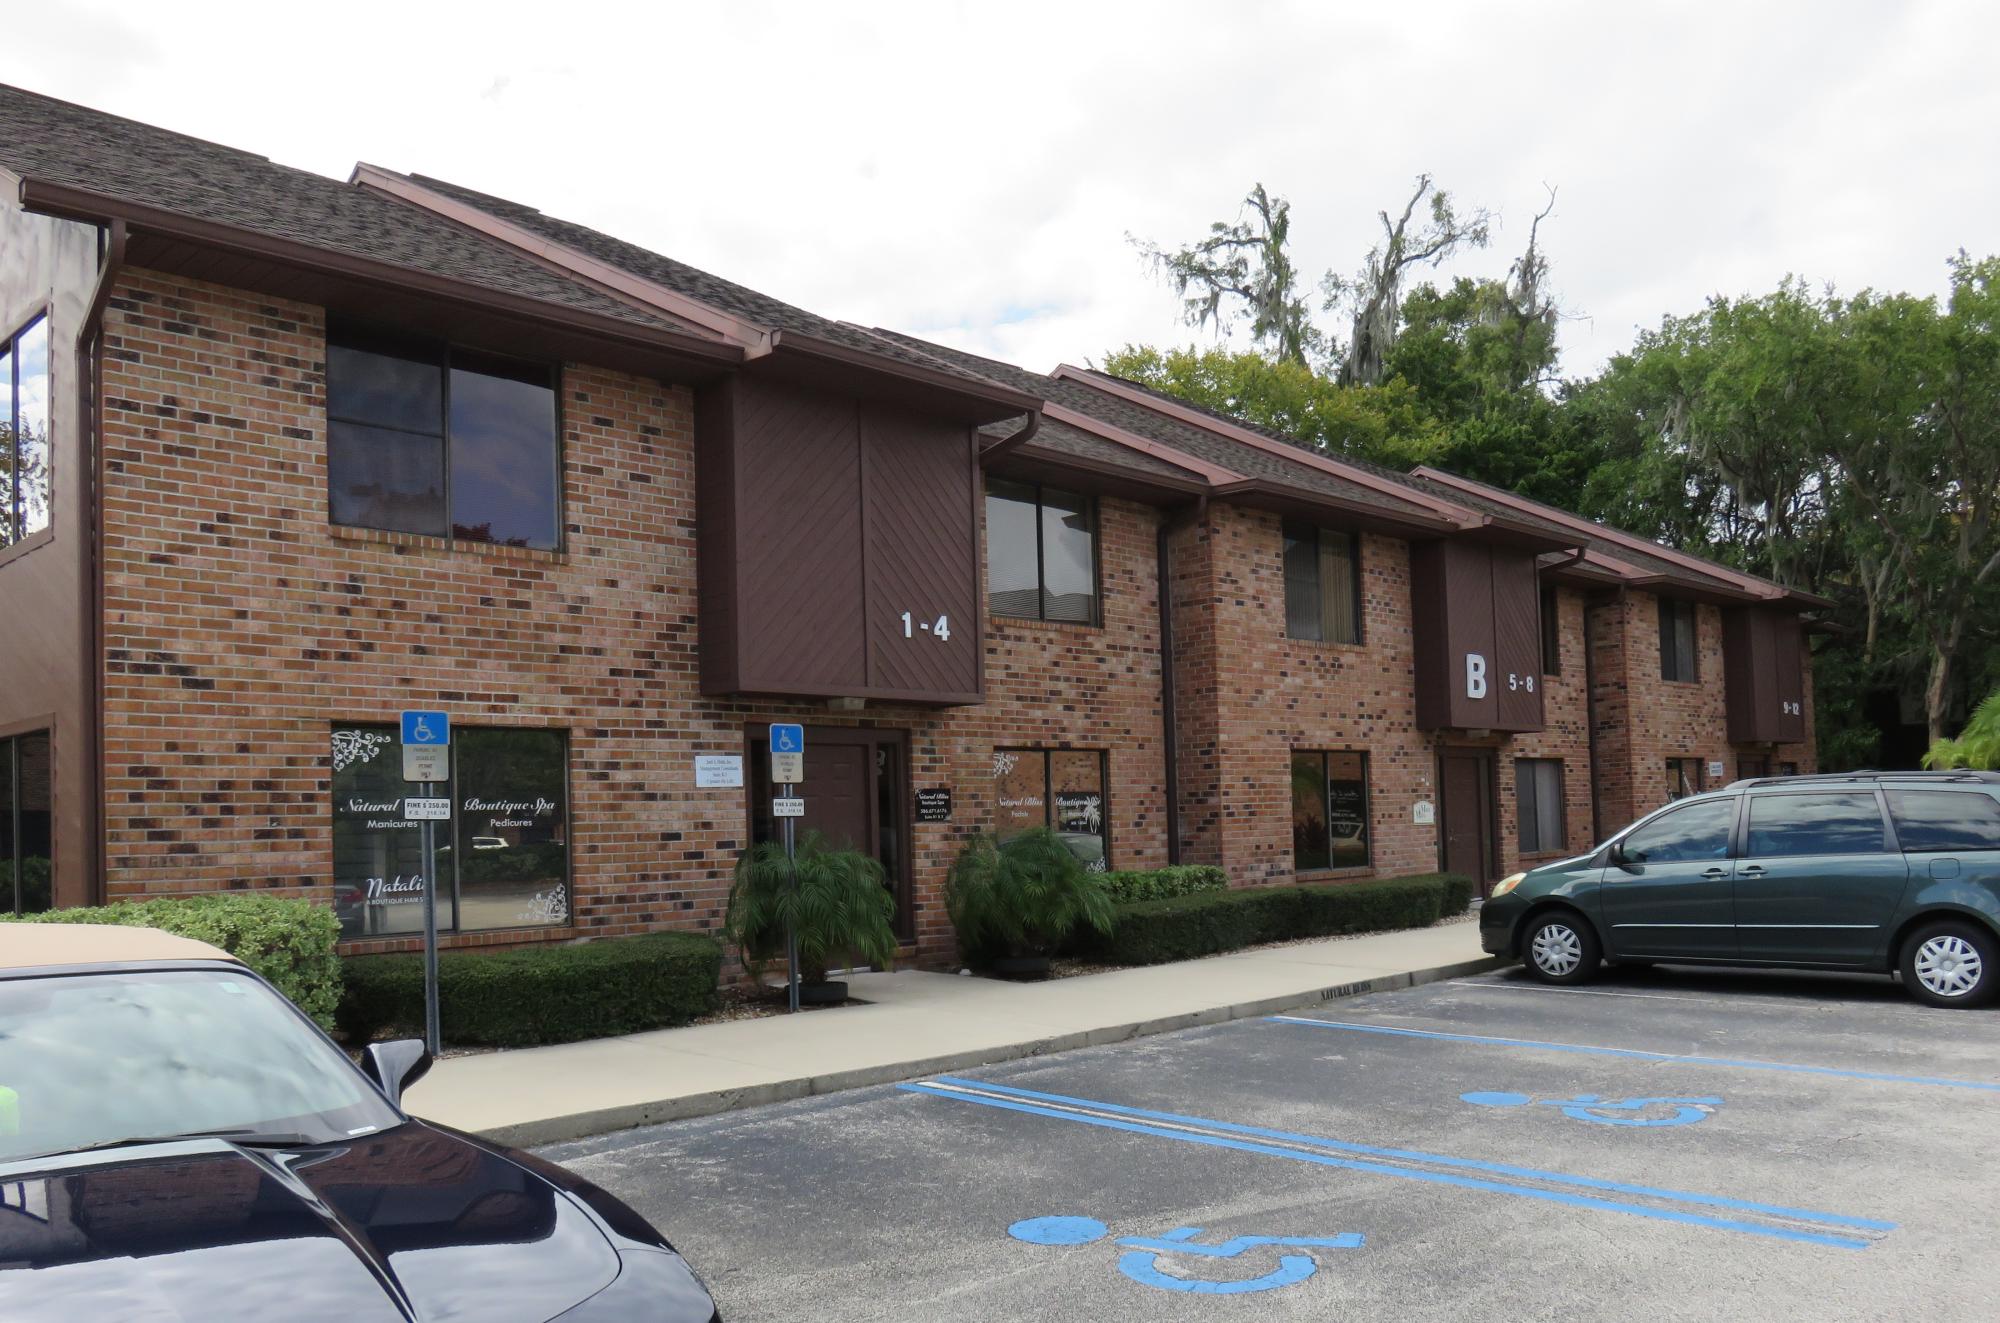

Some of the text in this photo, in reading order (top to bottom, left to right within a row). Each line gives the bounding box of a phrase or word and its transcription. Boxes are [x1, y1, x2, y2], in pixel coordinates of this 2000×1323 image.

[1466, 653, 1487, 699] B
[1509, 673, 1533, 692] 5-8
[1783, 701, 1800, 716] 9-12
[340, 798, 401, 812] Natural
[464, 797, 556, 815] Boutique Spa
[366, 819, 419, 829] Manicures
[490, 818, 533, 828] Pedicures
[366, 874, 424, 899] Natali
[371, 897, 404, 905] BOUTIQUE
